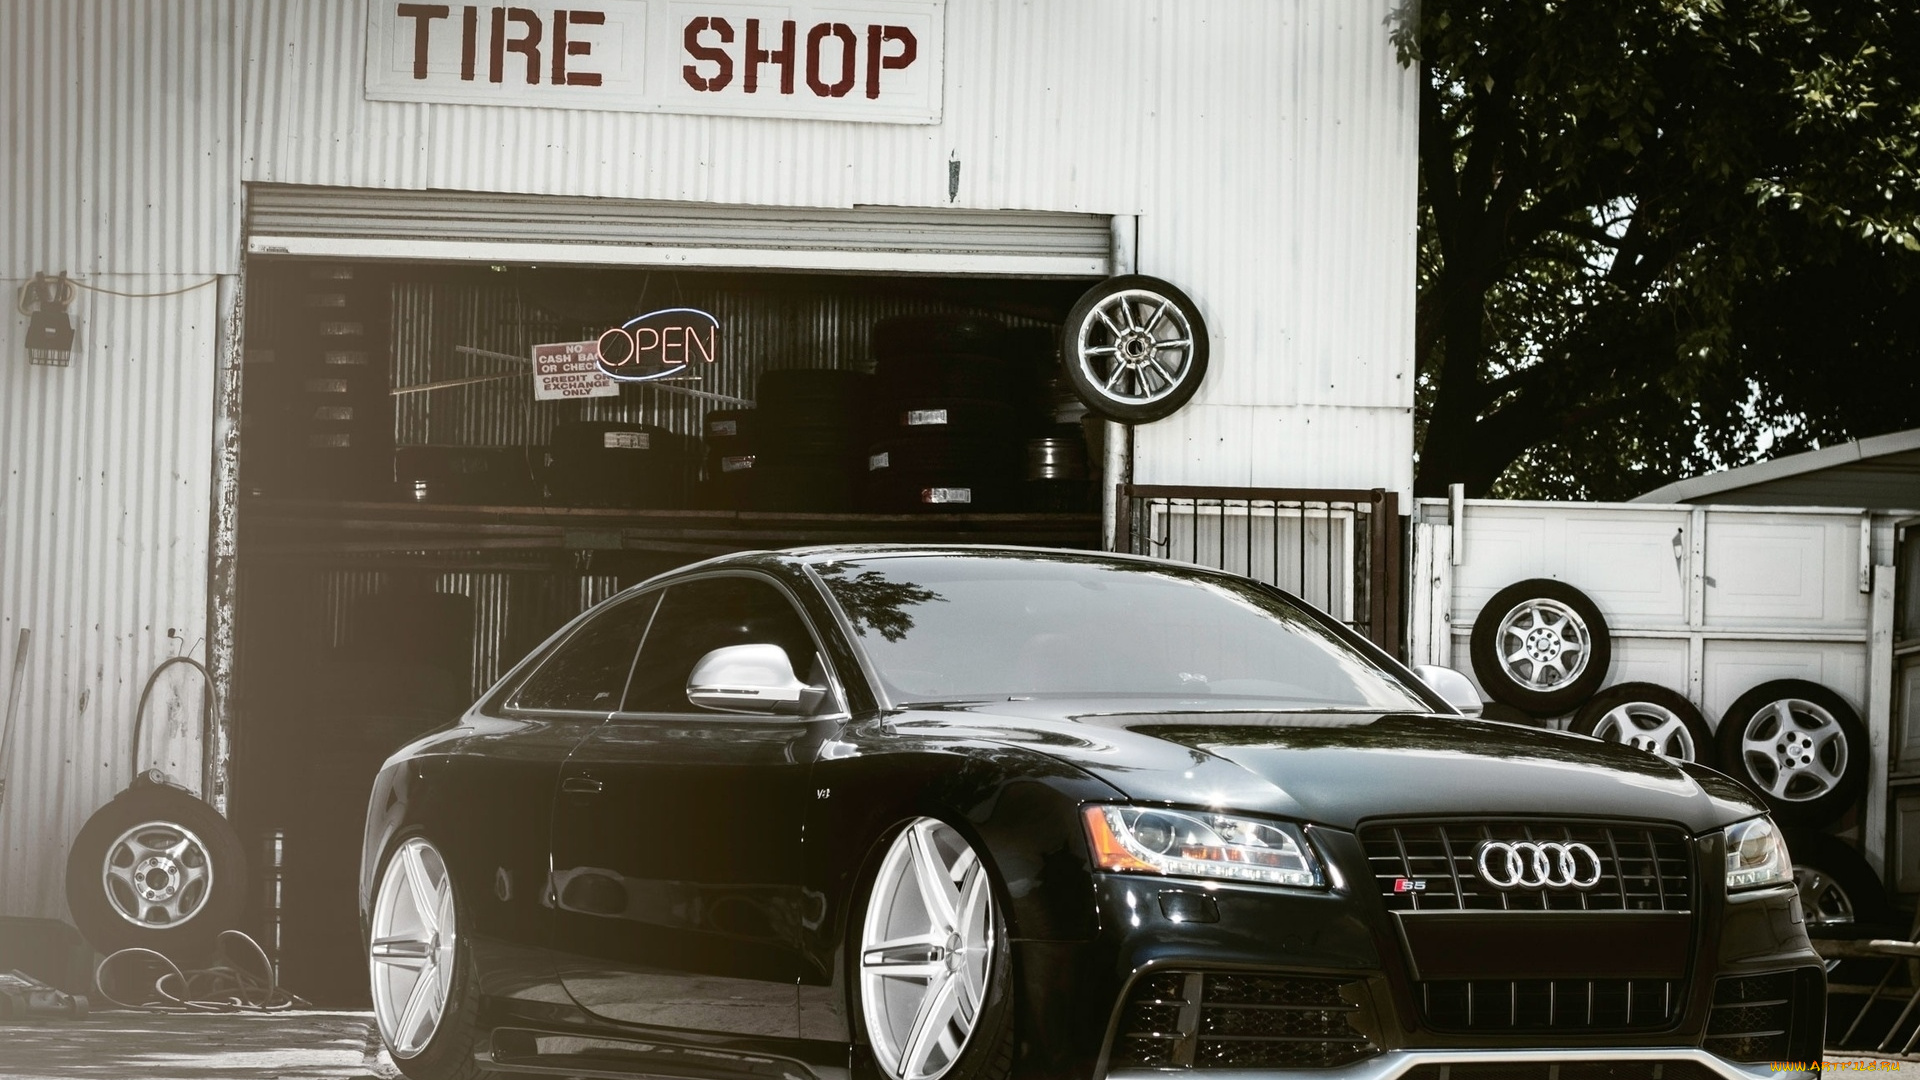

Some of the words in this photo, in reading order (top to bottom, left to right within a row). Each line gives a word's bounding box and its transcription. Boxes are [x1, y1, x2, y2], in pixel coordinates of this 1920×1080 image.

[396, 2, 606, 87] TIRE
[682, 16, 918, 101] SHOP
[565, 344, 583, 354] NO
[597, 325, 716, 367] OPEN
[538, 354, 572, 364] CASH
[578, 353, 599, 364] BAC
[541, 364, 557, 373] OR
[542, 374, 588, 384] CREDIT
[543, 380, 611, 391] EXCHANGE
[562, 388, 593, 397] ONLY
[1401, 880, 1426, 891] S5
